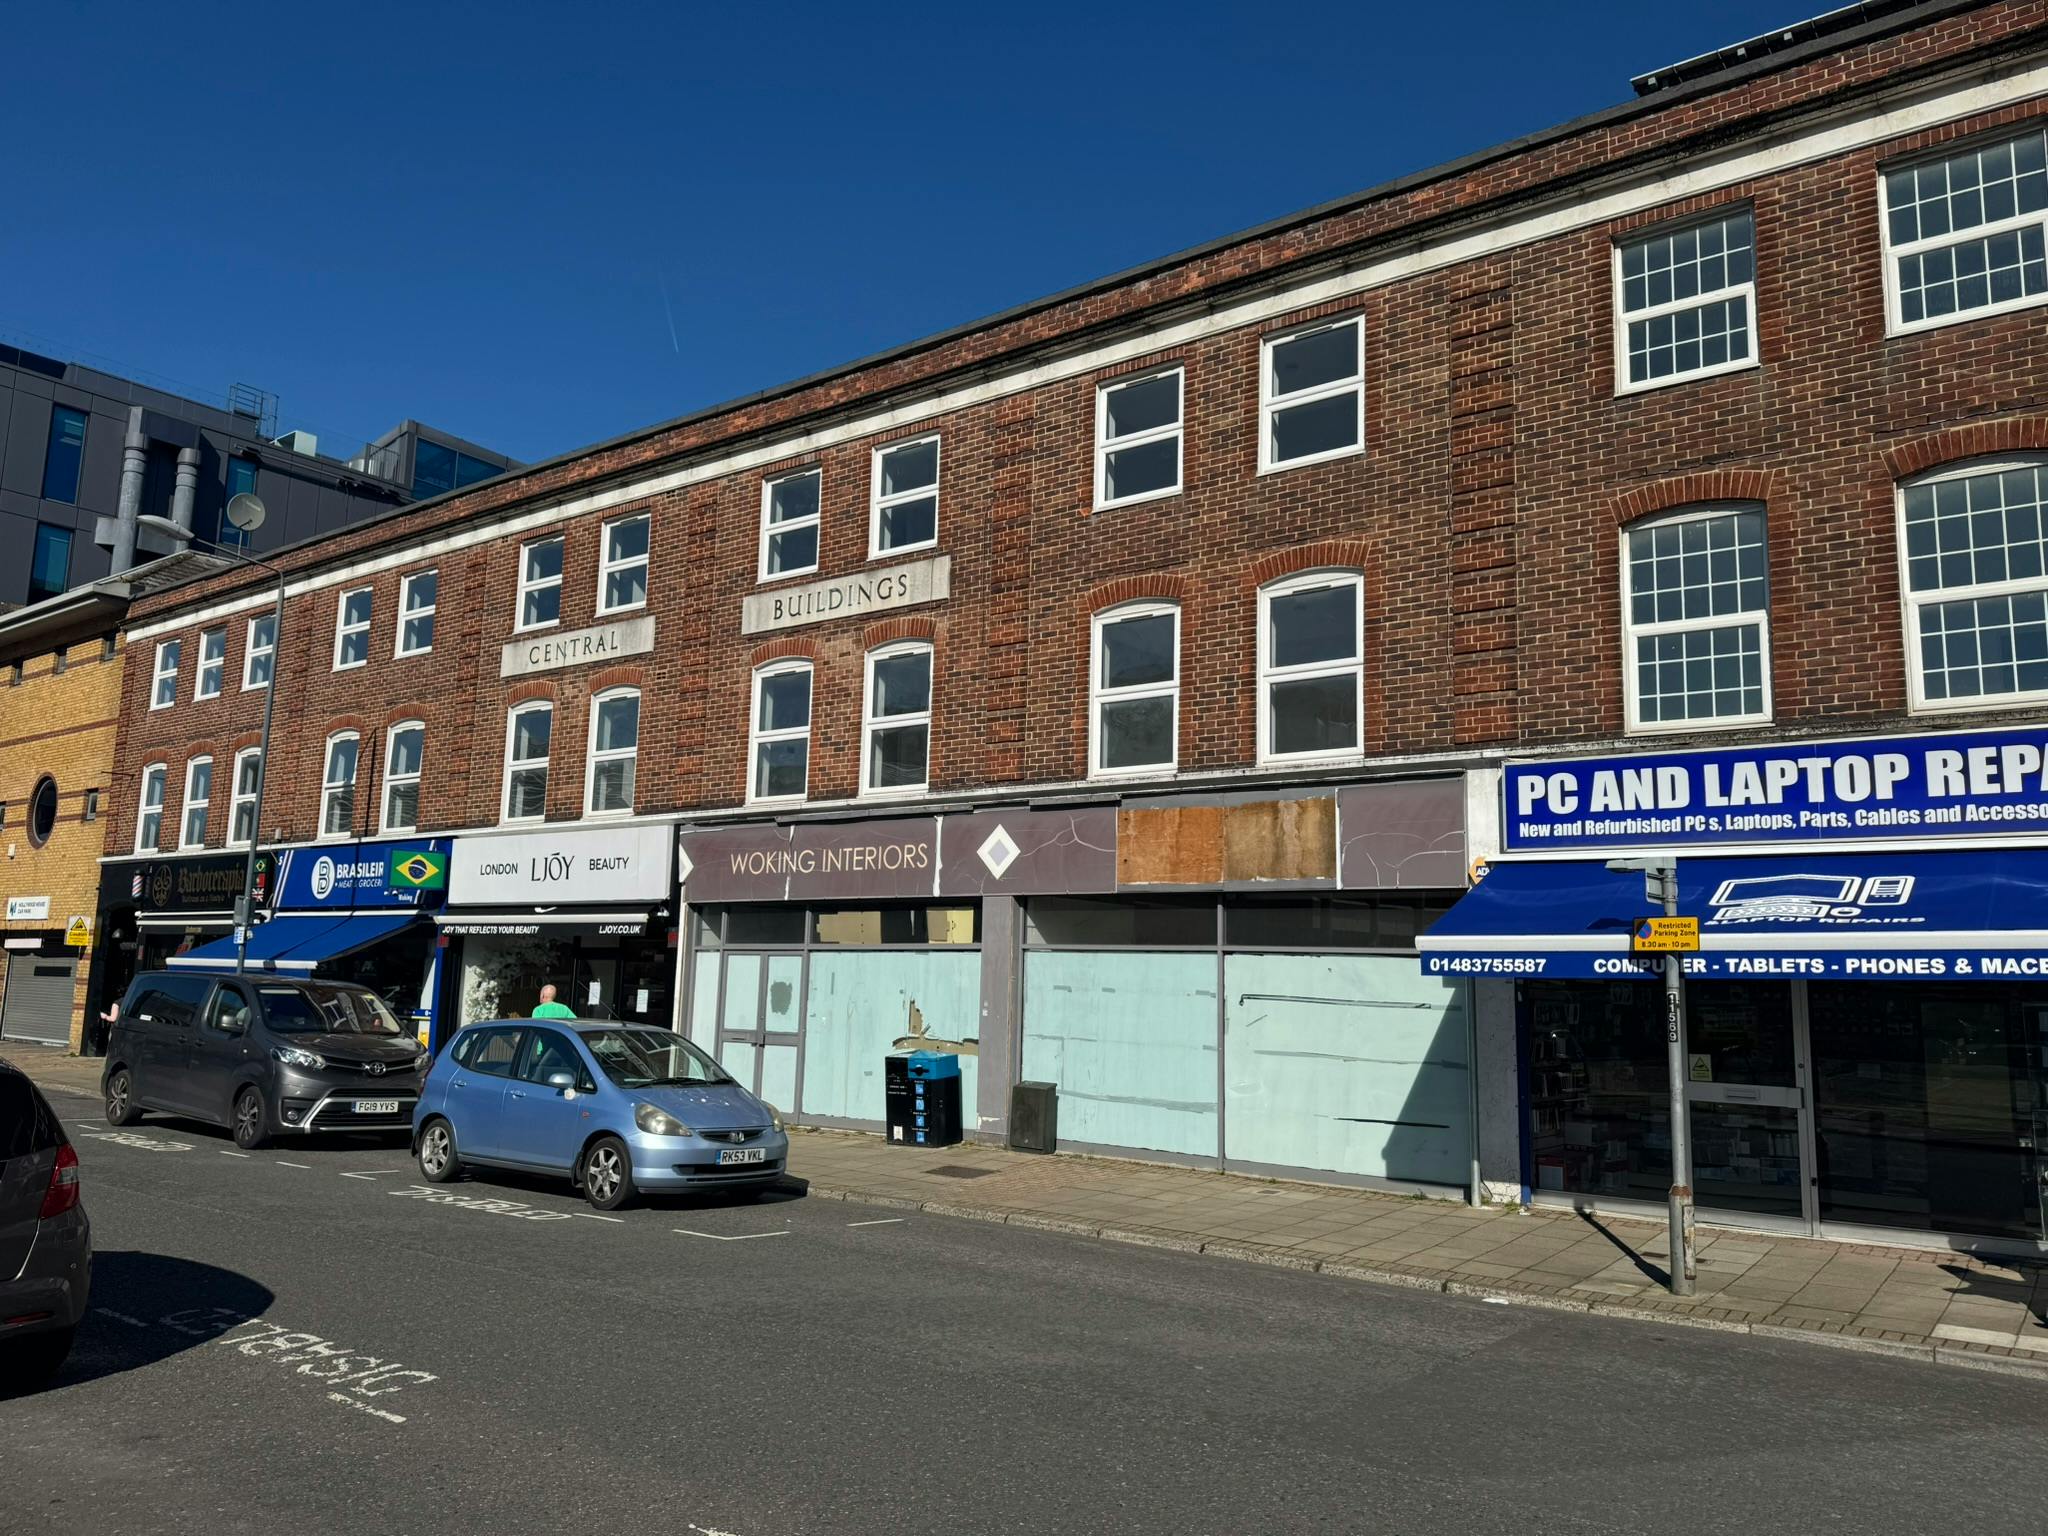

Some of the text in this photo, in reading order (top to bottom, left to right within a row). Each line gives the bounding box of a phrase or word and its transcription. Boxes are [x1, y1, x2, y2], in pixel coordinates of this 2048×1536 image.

[773, 573, 909, 621] BUILDINGS
[529, 630, 619, 665] CENTRAL
[1517, 743, 2048, 816] PC AND LAPTOP REP
[1519, 822, 1552, 838] New
[1553, 820, 1582, 837] and
[1585, 816, 1682, 836] Refurbished
[1725, 813, 1798, 831] Laptops,
[1799, 811, 1853, 829] Parts,
[1855, 808, 1921, 827] Cables
[1924, 805, 1962, 824] and
[480, 862, 519, 876] LONDON
[589, 856, 630, 871] BEAUTY
[730, 843, 929, 876] WOKING INTERIORS
[442, 925, 540, 934] JOY THAT REFLECTS YOUR BEAUTY
[598, 924, 642, 935] LJOY.CO.UK
[1658, 921, 1692, 930] Restricted
[1818, 916, 1926, 924] REPAIRS
[1654, 929, 1696, 938] Parking Zone
[1429, 957, 1547, 973] 01483755587
[1593, 957, 1707, 974] COMPUER
[1724, 957, 1825, 974] TABLETS
[1845, 957, 1947, 975] PHONES
[1954, 957, 1973, 974] &
[1669, 993, 1678, 1041] 11569
[358, 1102, 396, 1112] FG19 YVS
[721, 1149, 763, 1163] RK53 VKL
[387, 1189, 574, 1221] DISABLED
